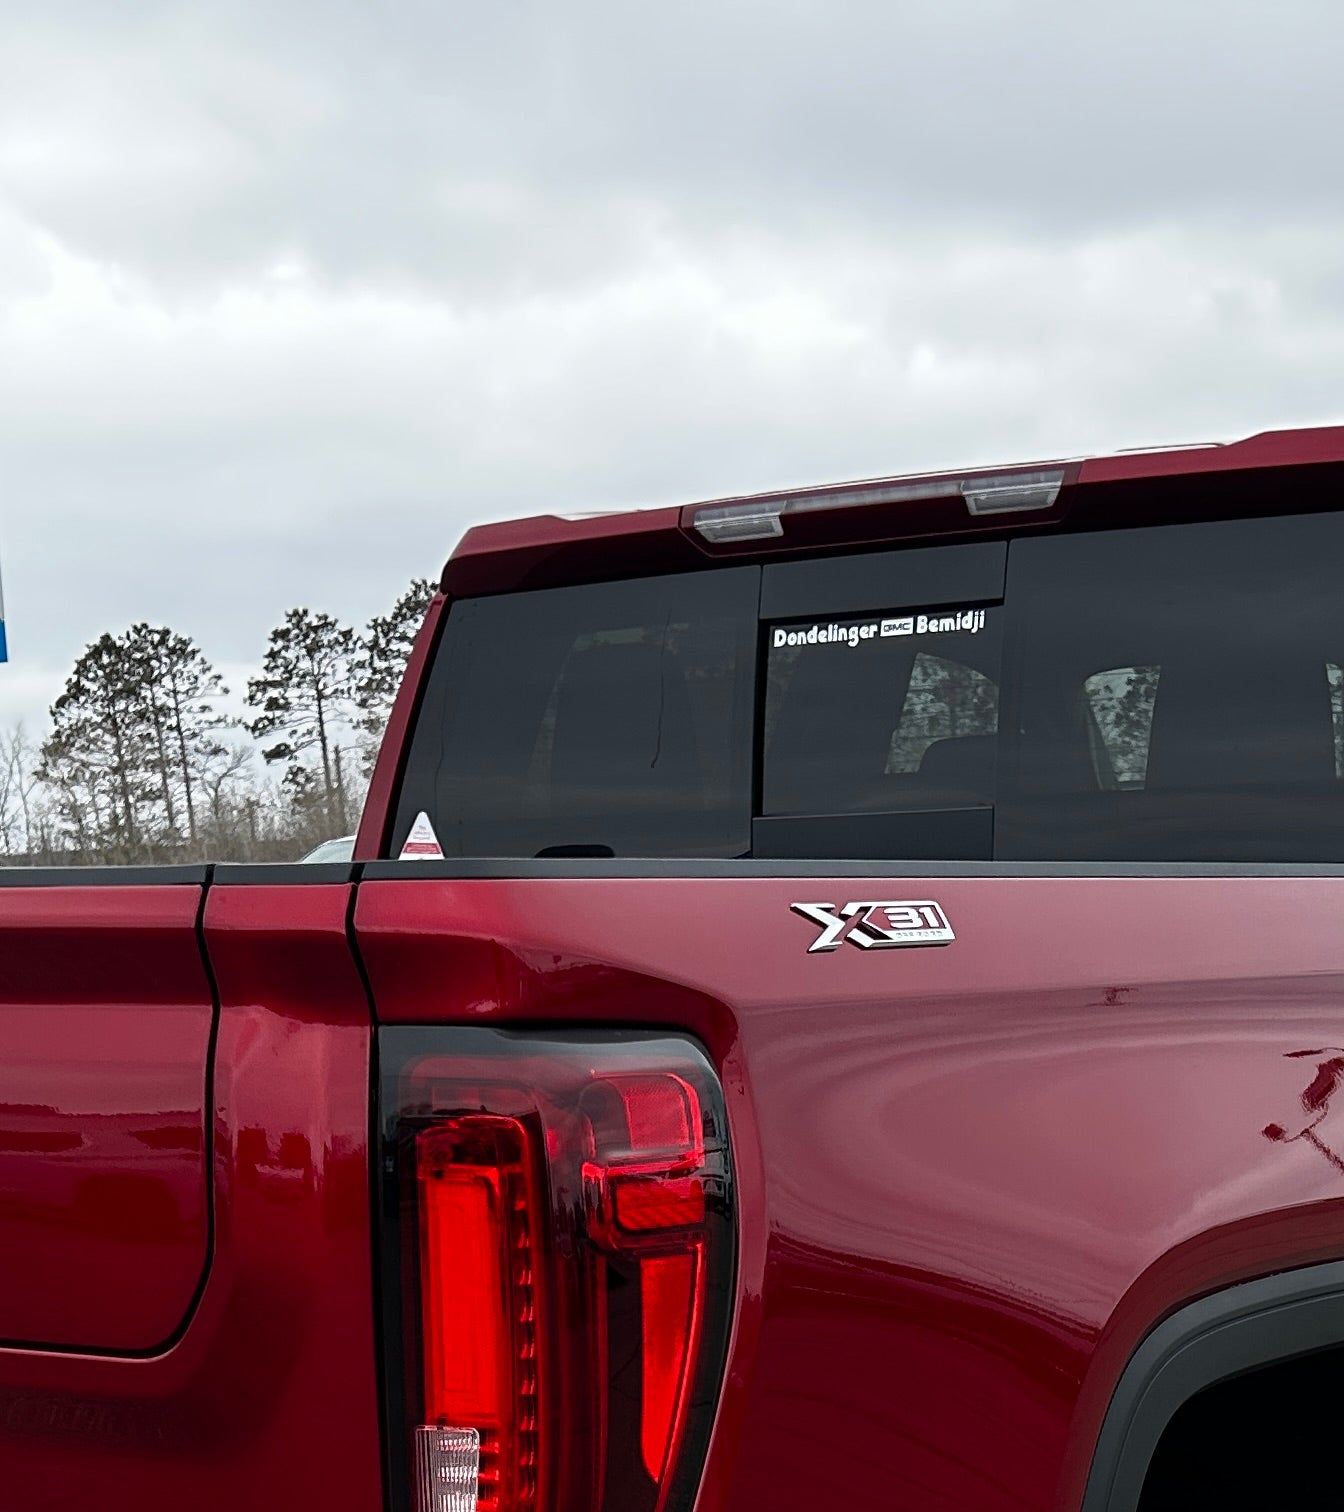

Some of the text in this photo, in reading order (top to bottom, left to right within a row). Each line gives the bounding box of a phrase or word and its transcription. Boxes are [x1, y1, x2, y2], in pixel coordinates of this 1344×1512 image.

[773, 609, 986, 648] Dondelinger GMC Bemidji
